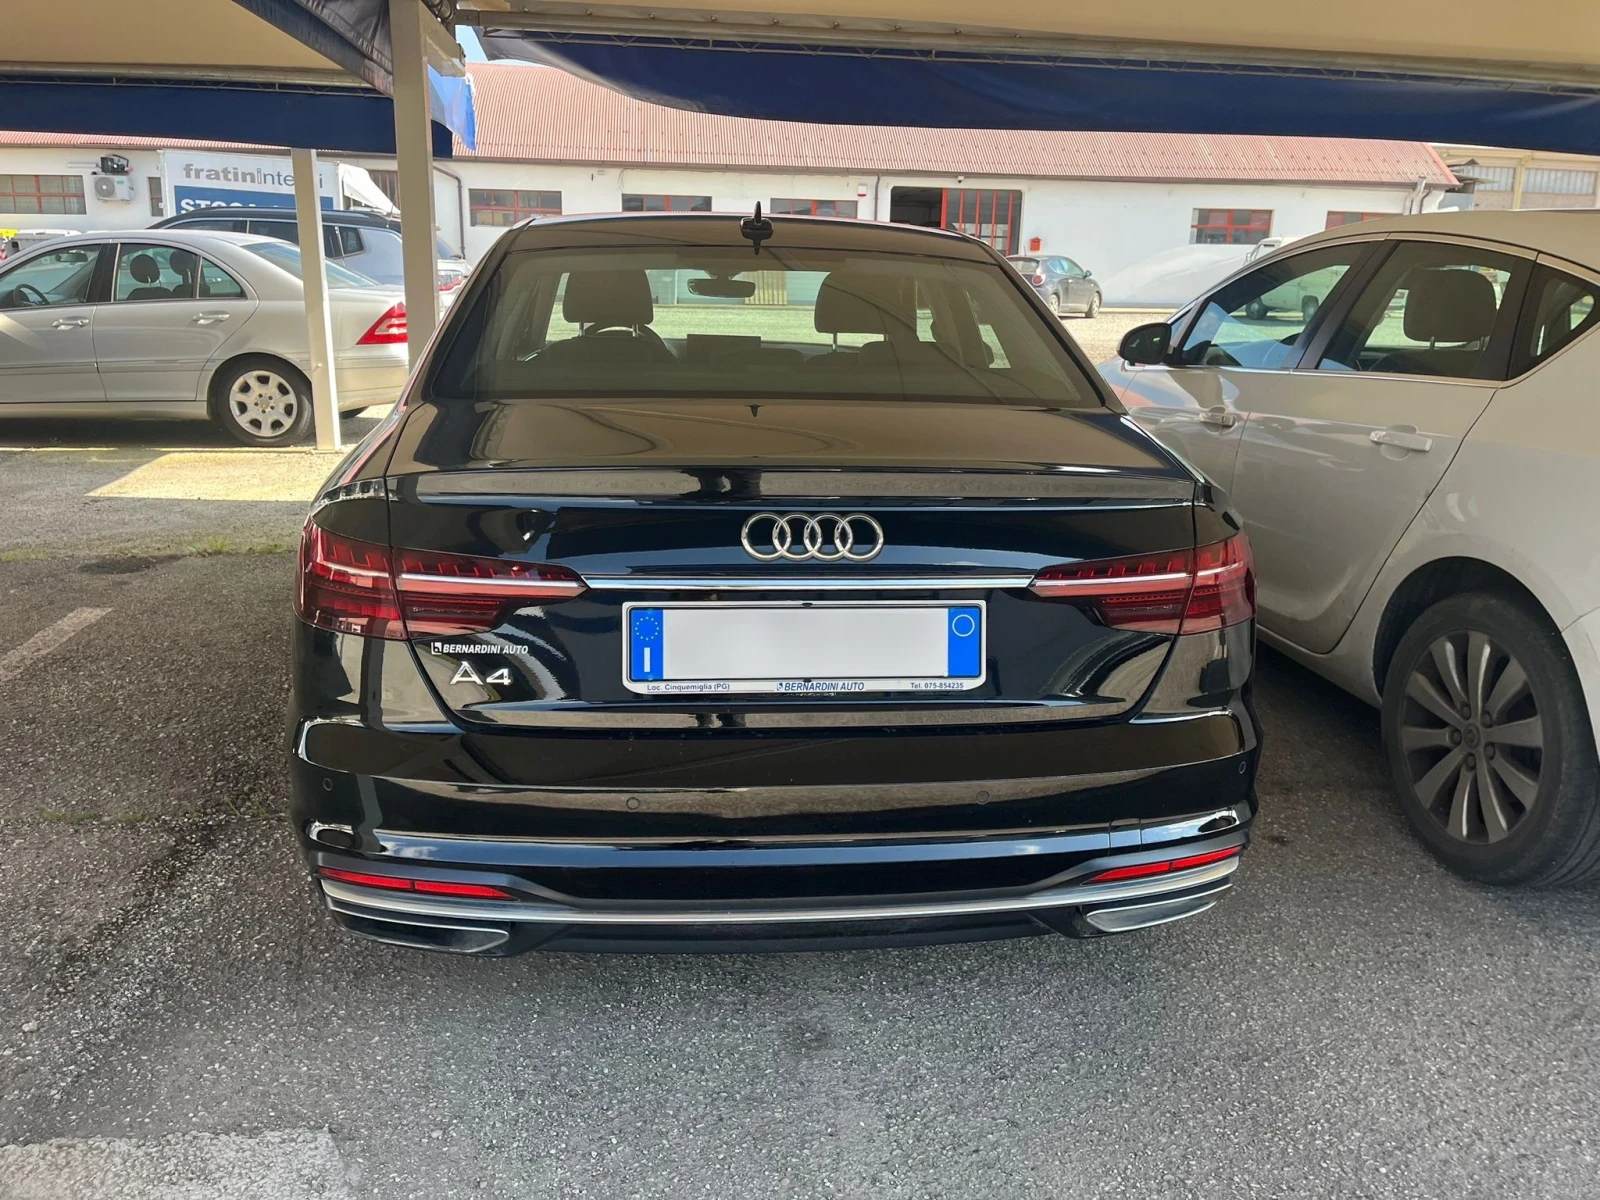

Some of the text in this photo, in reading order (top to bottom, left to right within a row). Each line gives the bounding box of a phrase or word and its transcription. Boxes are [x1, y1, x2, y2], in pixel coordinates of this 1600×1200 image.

[443, 644, 529, 654] BERNARDINI AUTO
[449, 661, 512, 686] A4
[664, 683, 713, 692] Cinquemiglia
[713, 683, 730, 692] (PG)
[784, 682, 865, 691] BERNARDINI AUTO
[910, 682, 922, 690] Tel.
